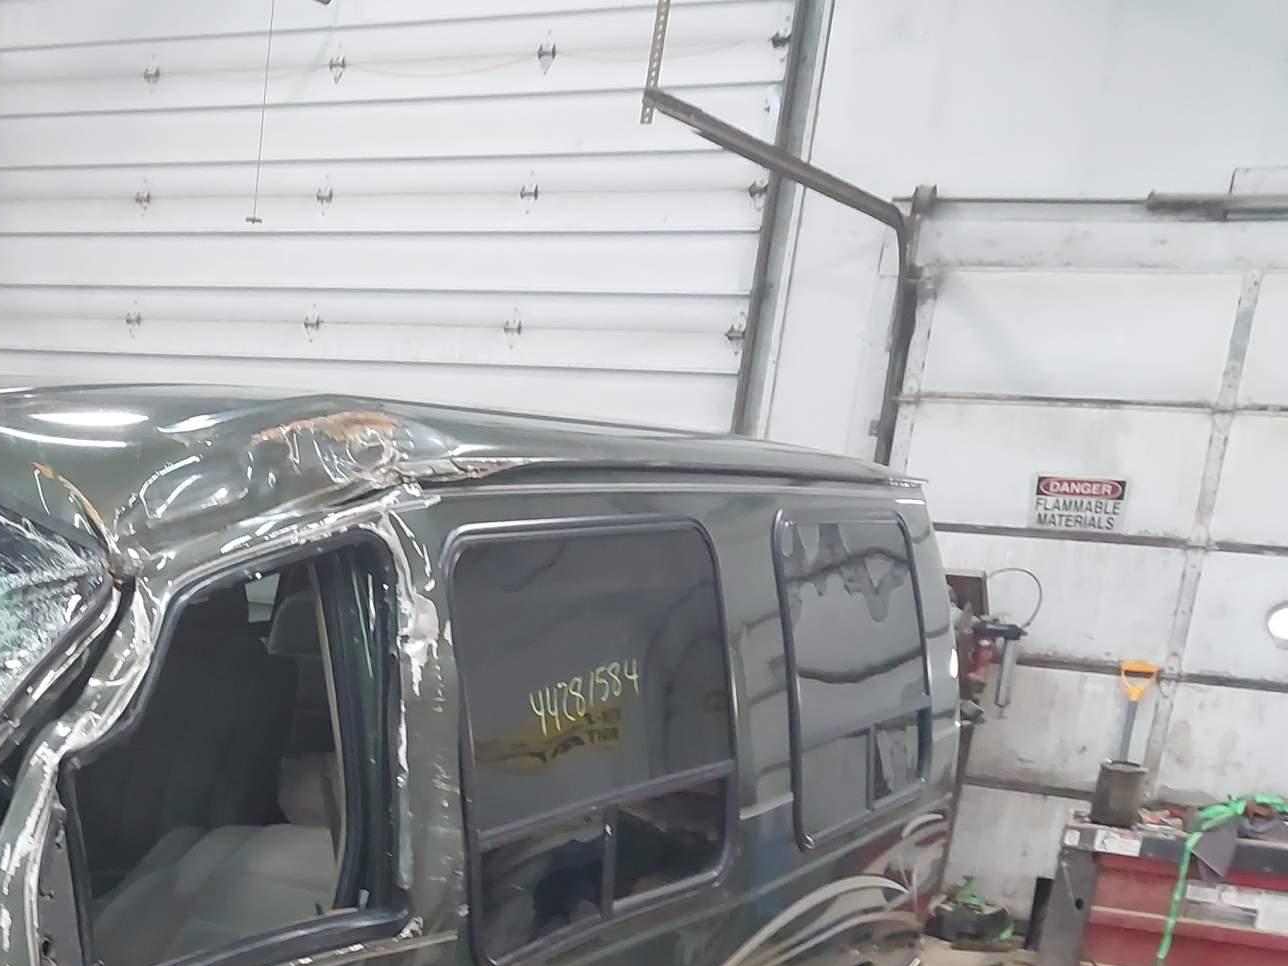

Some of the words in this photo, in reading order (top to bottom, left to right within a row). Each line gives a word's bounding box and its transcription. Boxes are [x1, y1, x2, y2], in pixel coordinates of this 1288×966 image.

[1049, 480, 1113, 496] DANGER
[1035, 497, 1122, 516] FLAMMABLE
[1036, 512, 1115, 531] MATERIALS
[529, 658, 640, 736] 44281584
